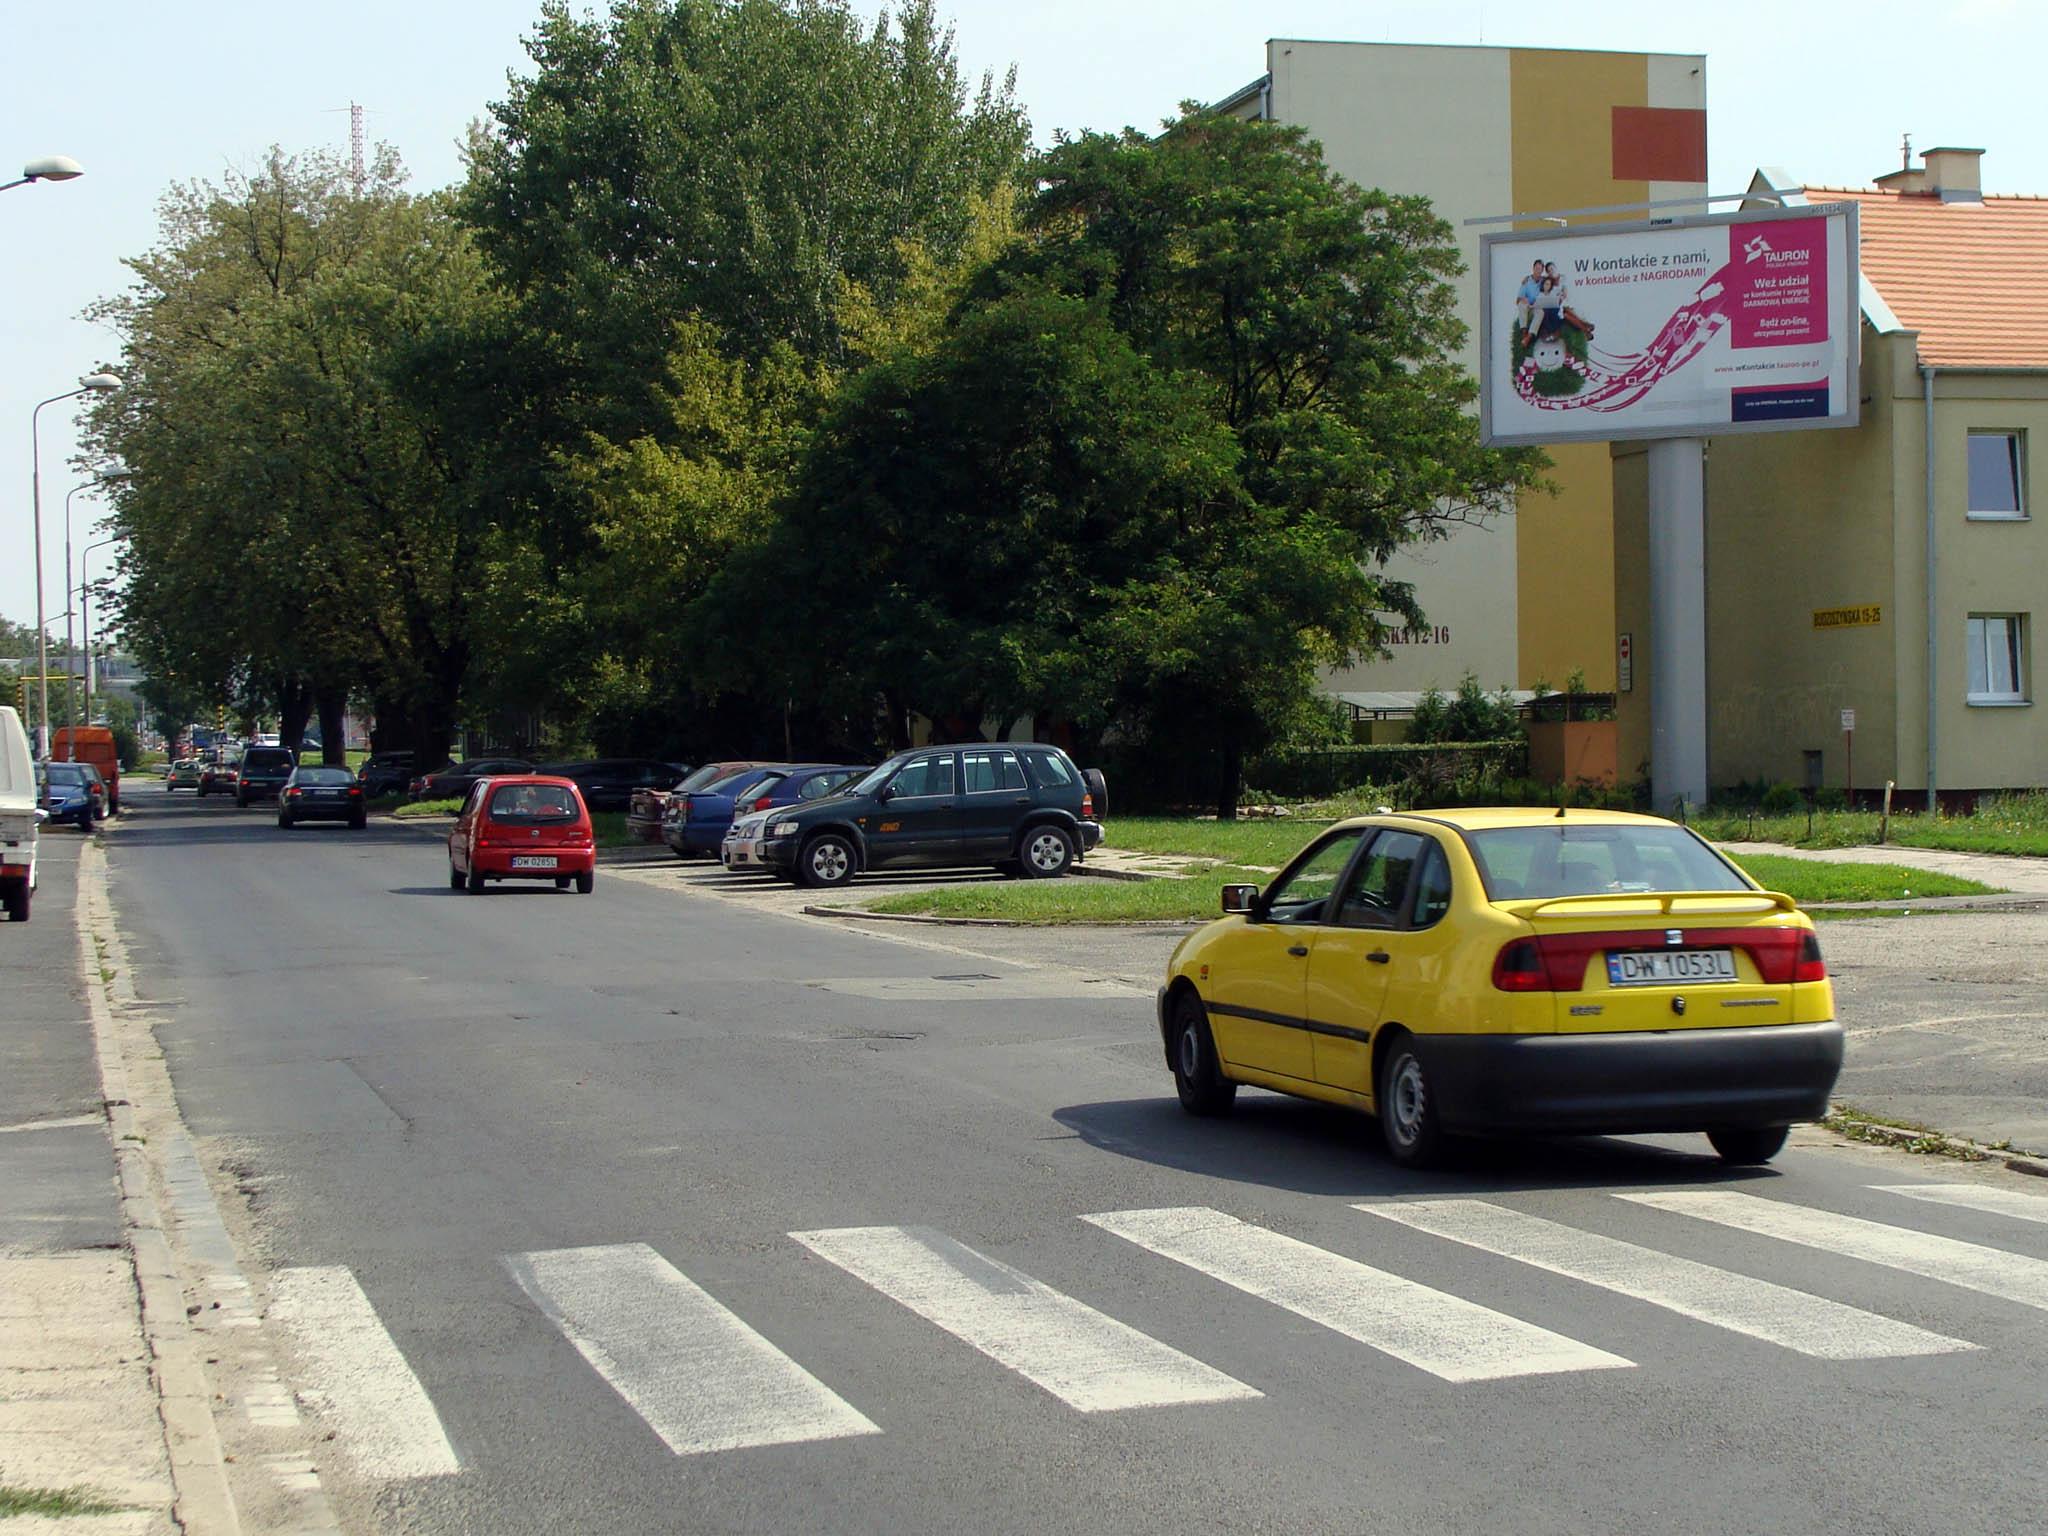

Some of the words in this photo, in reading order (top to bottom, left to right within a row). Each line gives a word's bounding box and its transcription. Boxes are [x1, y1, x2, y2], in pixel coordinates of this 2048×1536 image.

[1574, 259, 1590, 272] W
[1593, 254, 1657, 271] kontakcie
[1661, 255, 1669, 265] z
[1673, 249, 1711, 265] nami,
[1763, 250, 1809, 262] TAURON
[1575, 278, 1583, 286] w
[1586, 273, 1631, 286] kontakcie
[1623, 955, 1655, 978] DW
[1664, 953, 1731, 977] 1053L
